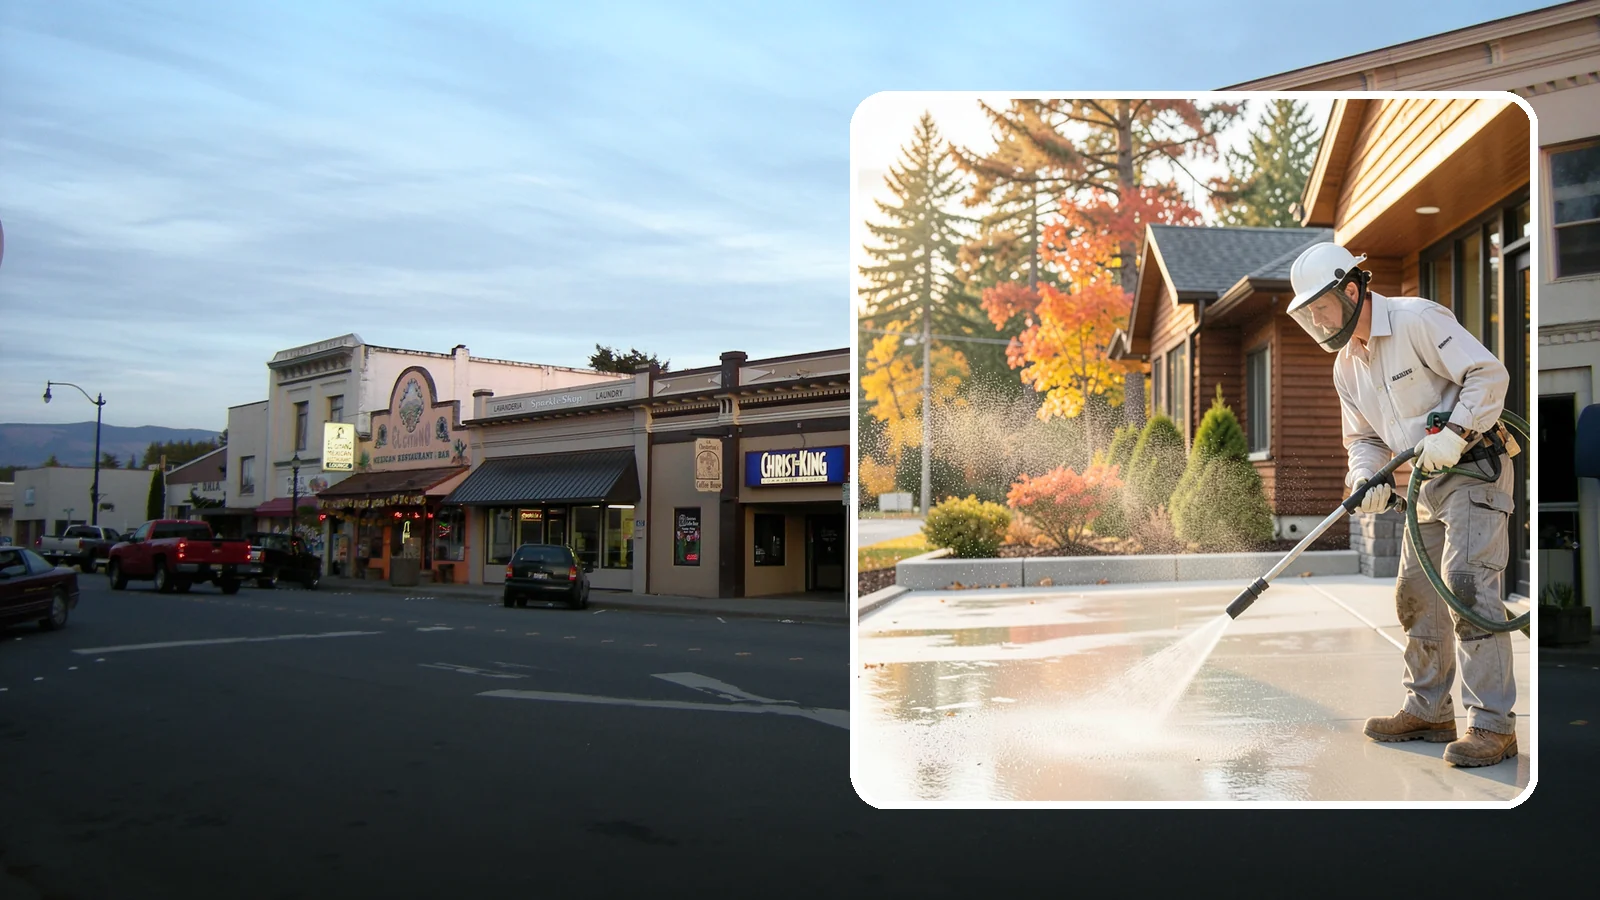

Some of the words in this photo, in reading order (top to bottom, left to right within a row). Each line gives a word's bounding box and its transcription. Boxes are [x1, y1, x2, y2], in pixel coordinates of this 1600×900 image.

[494, 402, 523, 413] LAVANDERIA
[530, 396, 561, 410] Sparkle
[562, 394, 582, 405] Shop
[595, 389, 623, 400] LAUNDRY
[374, 455, 396, 464] MEXICAN
[397, 451, 433, 462] RESTAURANT
[438, 450, 450, 459] BAR
[761, 452, 797, 478] CHRIST
[800, 450, 827, 476] KING
[696, 480, 709, 489] Coffee
[710, 480, 722, 489] House
